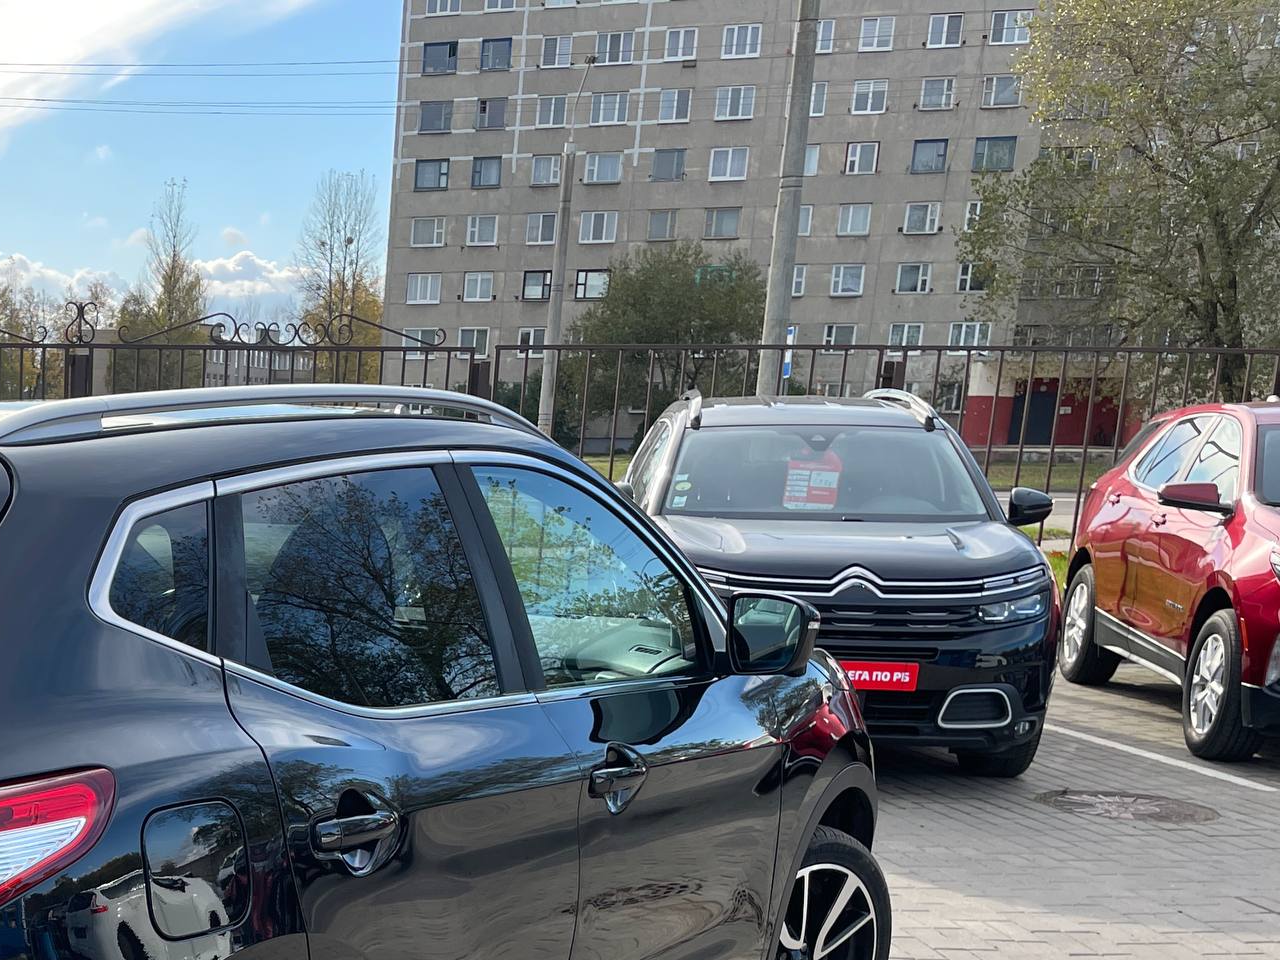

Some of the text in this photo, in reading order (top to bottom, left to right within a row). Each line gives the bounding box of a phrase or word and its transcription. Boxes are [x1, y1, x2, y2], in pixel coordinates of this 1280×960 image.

[845, 670, 910, 683] ЕГА ПО РБ
